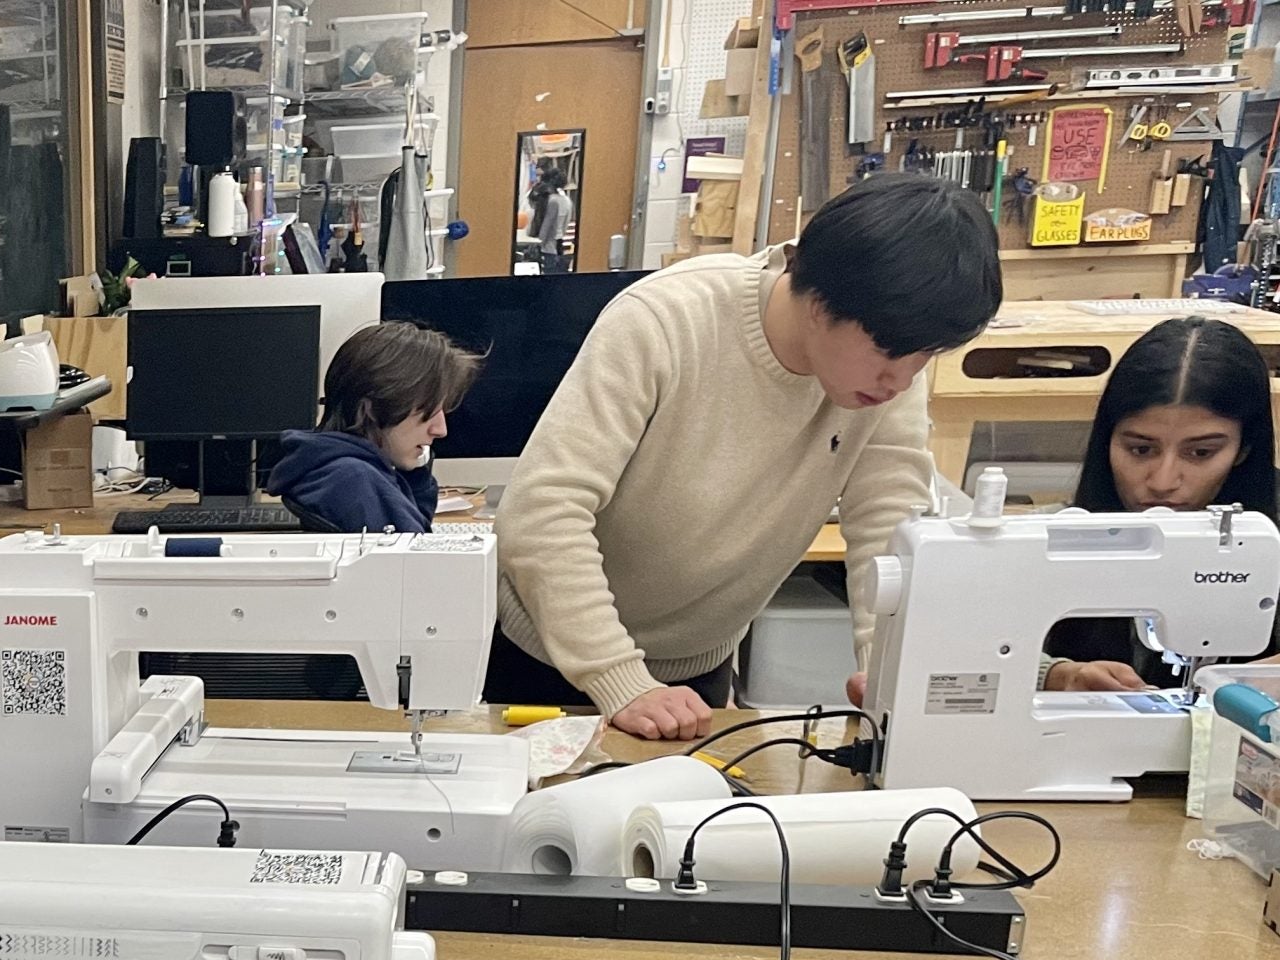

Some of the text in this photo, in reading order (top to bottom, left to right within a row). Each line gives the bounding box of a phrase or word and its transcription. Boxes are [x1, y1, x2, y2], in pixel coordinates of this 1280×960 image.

[1063, 128, 1098, 145] USE
[1036, 230, 1078, 242] GLASSES
[1194, 571, 1251, 583] brother
[4, 615, 58, 626] JANOME
